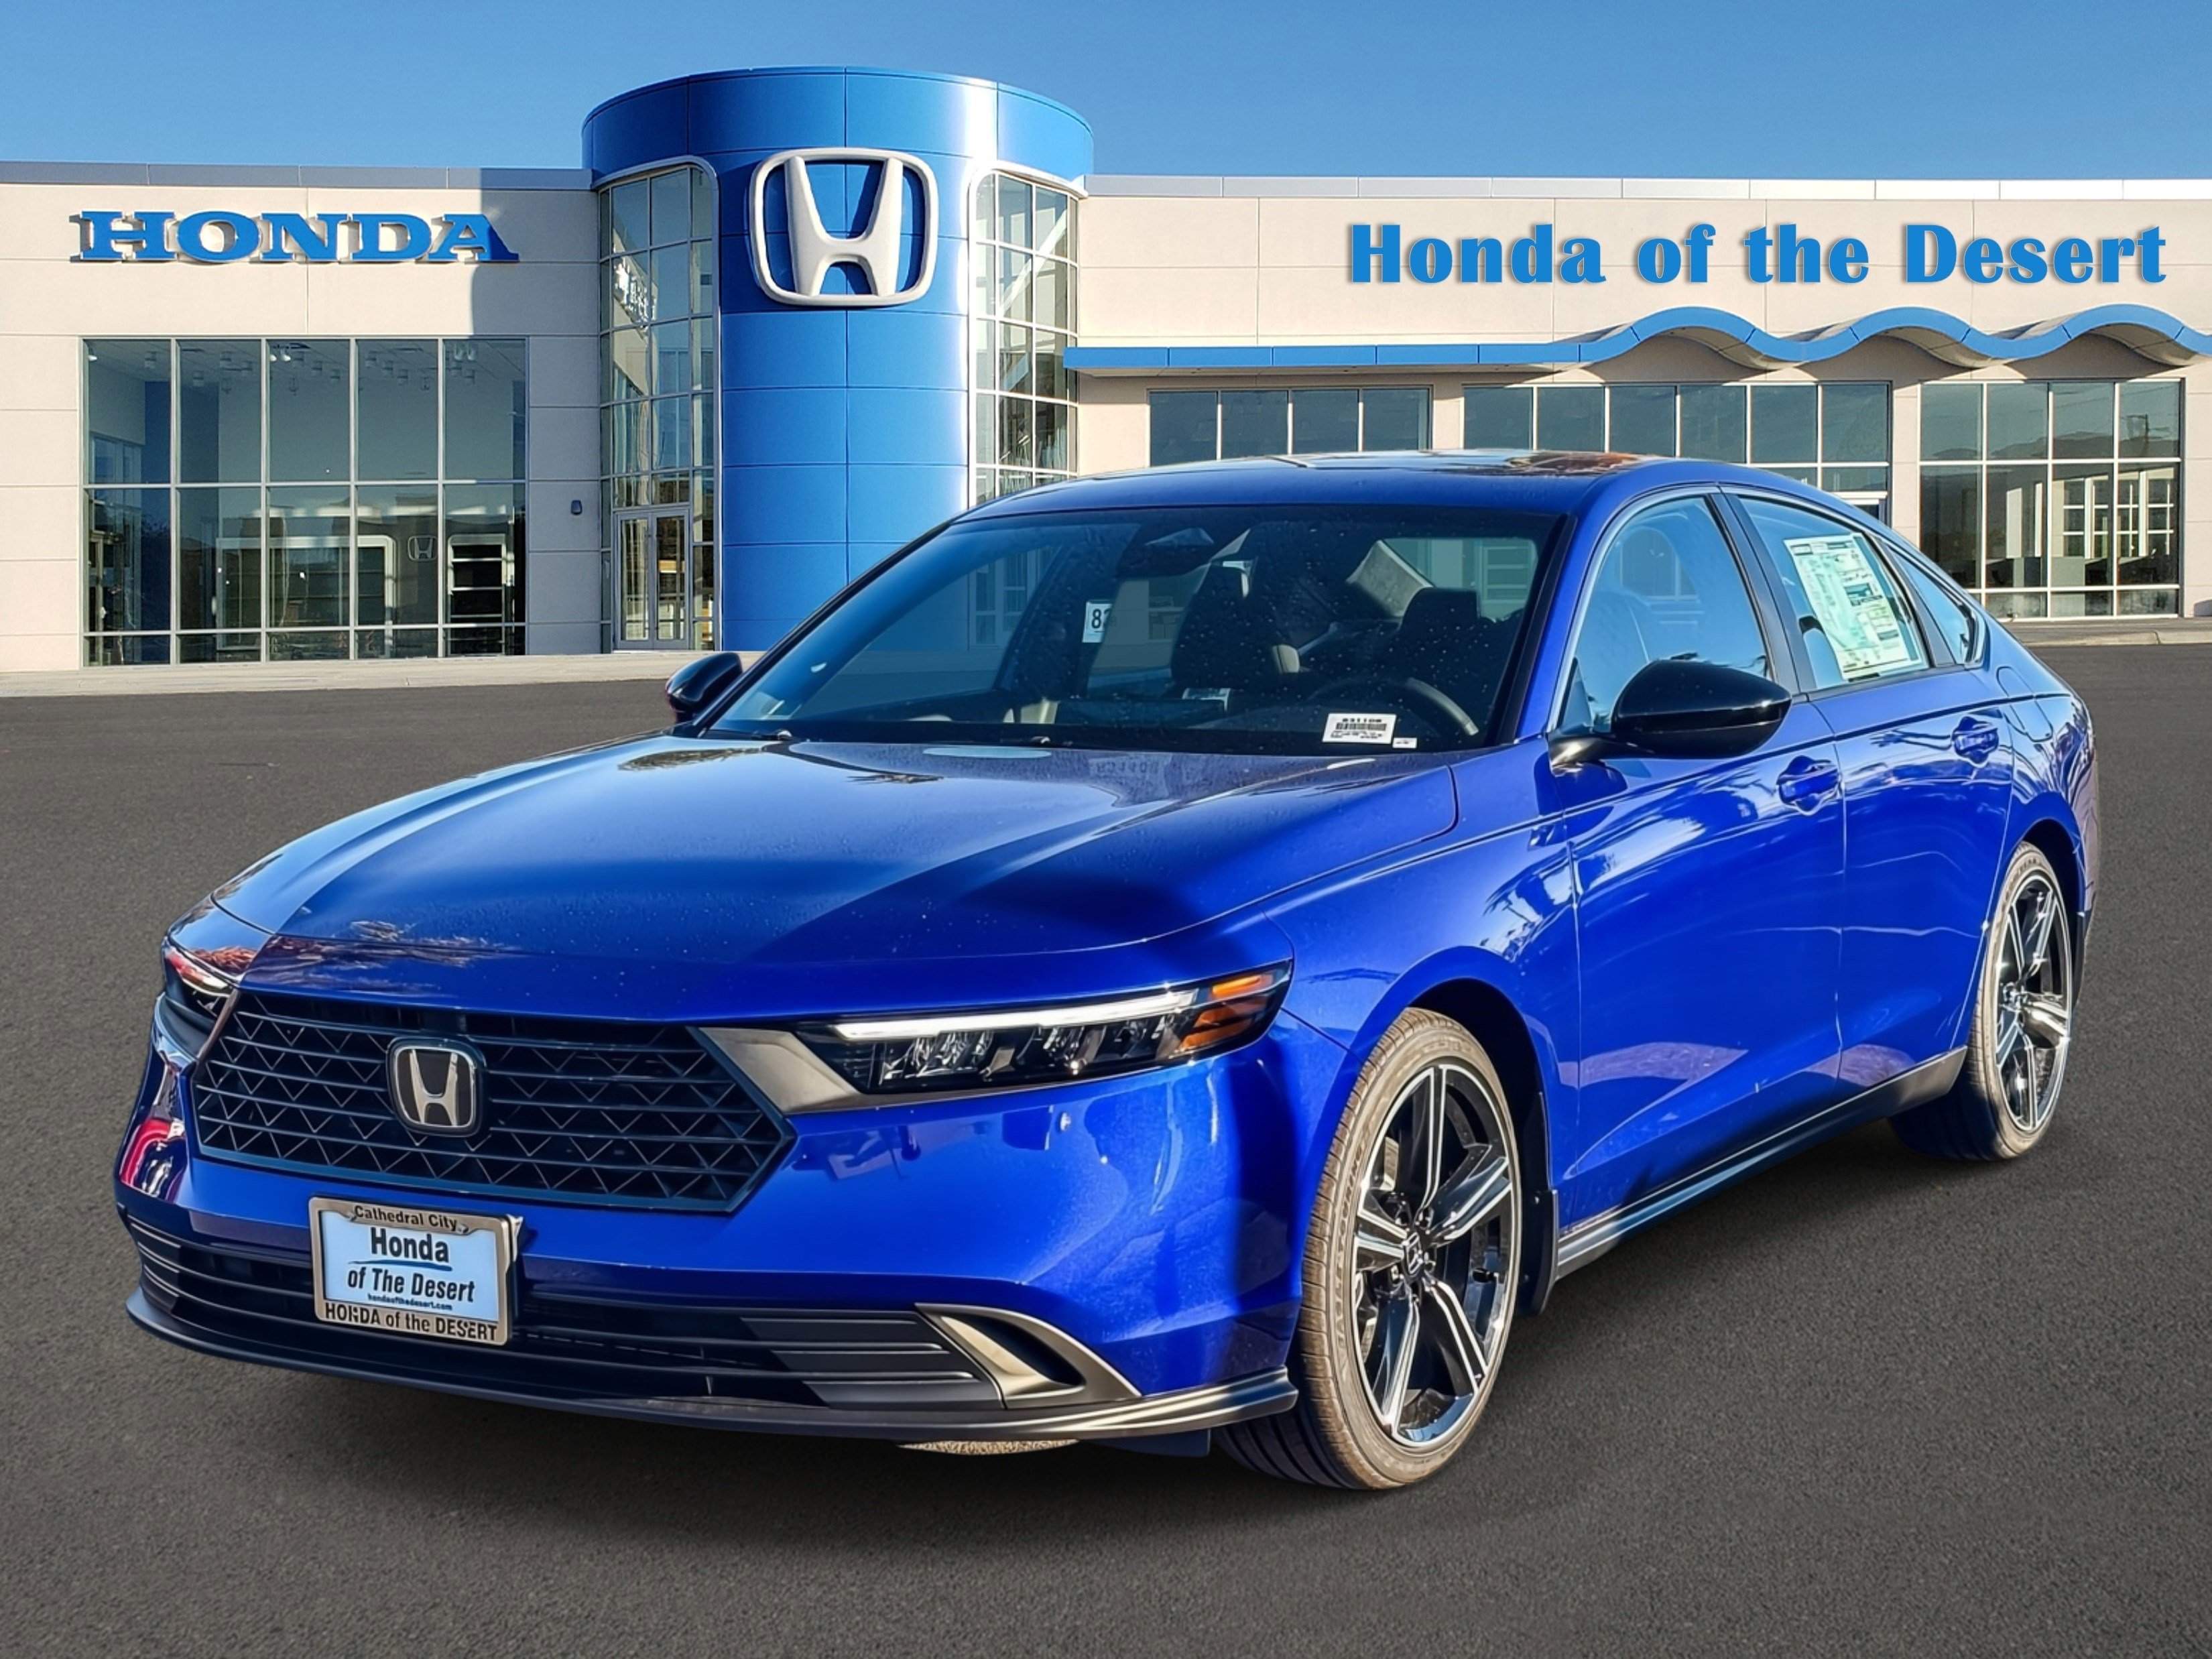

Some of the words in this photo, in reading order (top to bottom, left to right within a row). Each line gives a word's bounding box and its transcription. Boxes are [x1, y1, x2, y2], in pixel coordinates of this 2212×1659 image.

[80, 210, 519, 263] HONDA
[1351, 223, 1608, 284] Honda
[1637, 223, 1717, 284] of
[1743, 223, 1869, 284] the
[1906, 224, 2168, 284] Desert
[354, 1205, 424, 1226] Cathedral
[428, 1215, 457, 1231] City
[370, 1227, 449, 1263] Honda
[347, 1266, 367, 1289] of
[372, 1268, 405, 1294] The
[411, 1272, 475, 1302] Desert
[367, 1292, 454, 1311] hondaofthedesert.com
[325, 1302, 381, 1325] HONDA
[385, 1310, 402, 1328] of
[405, 1312, 431, 1333] the
[436, 1316, 498, 1341] DESERT
